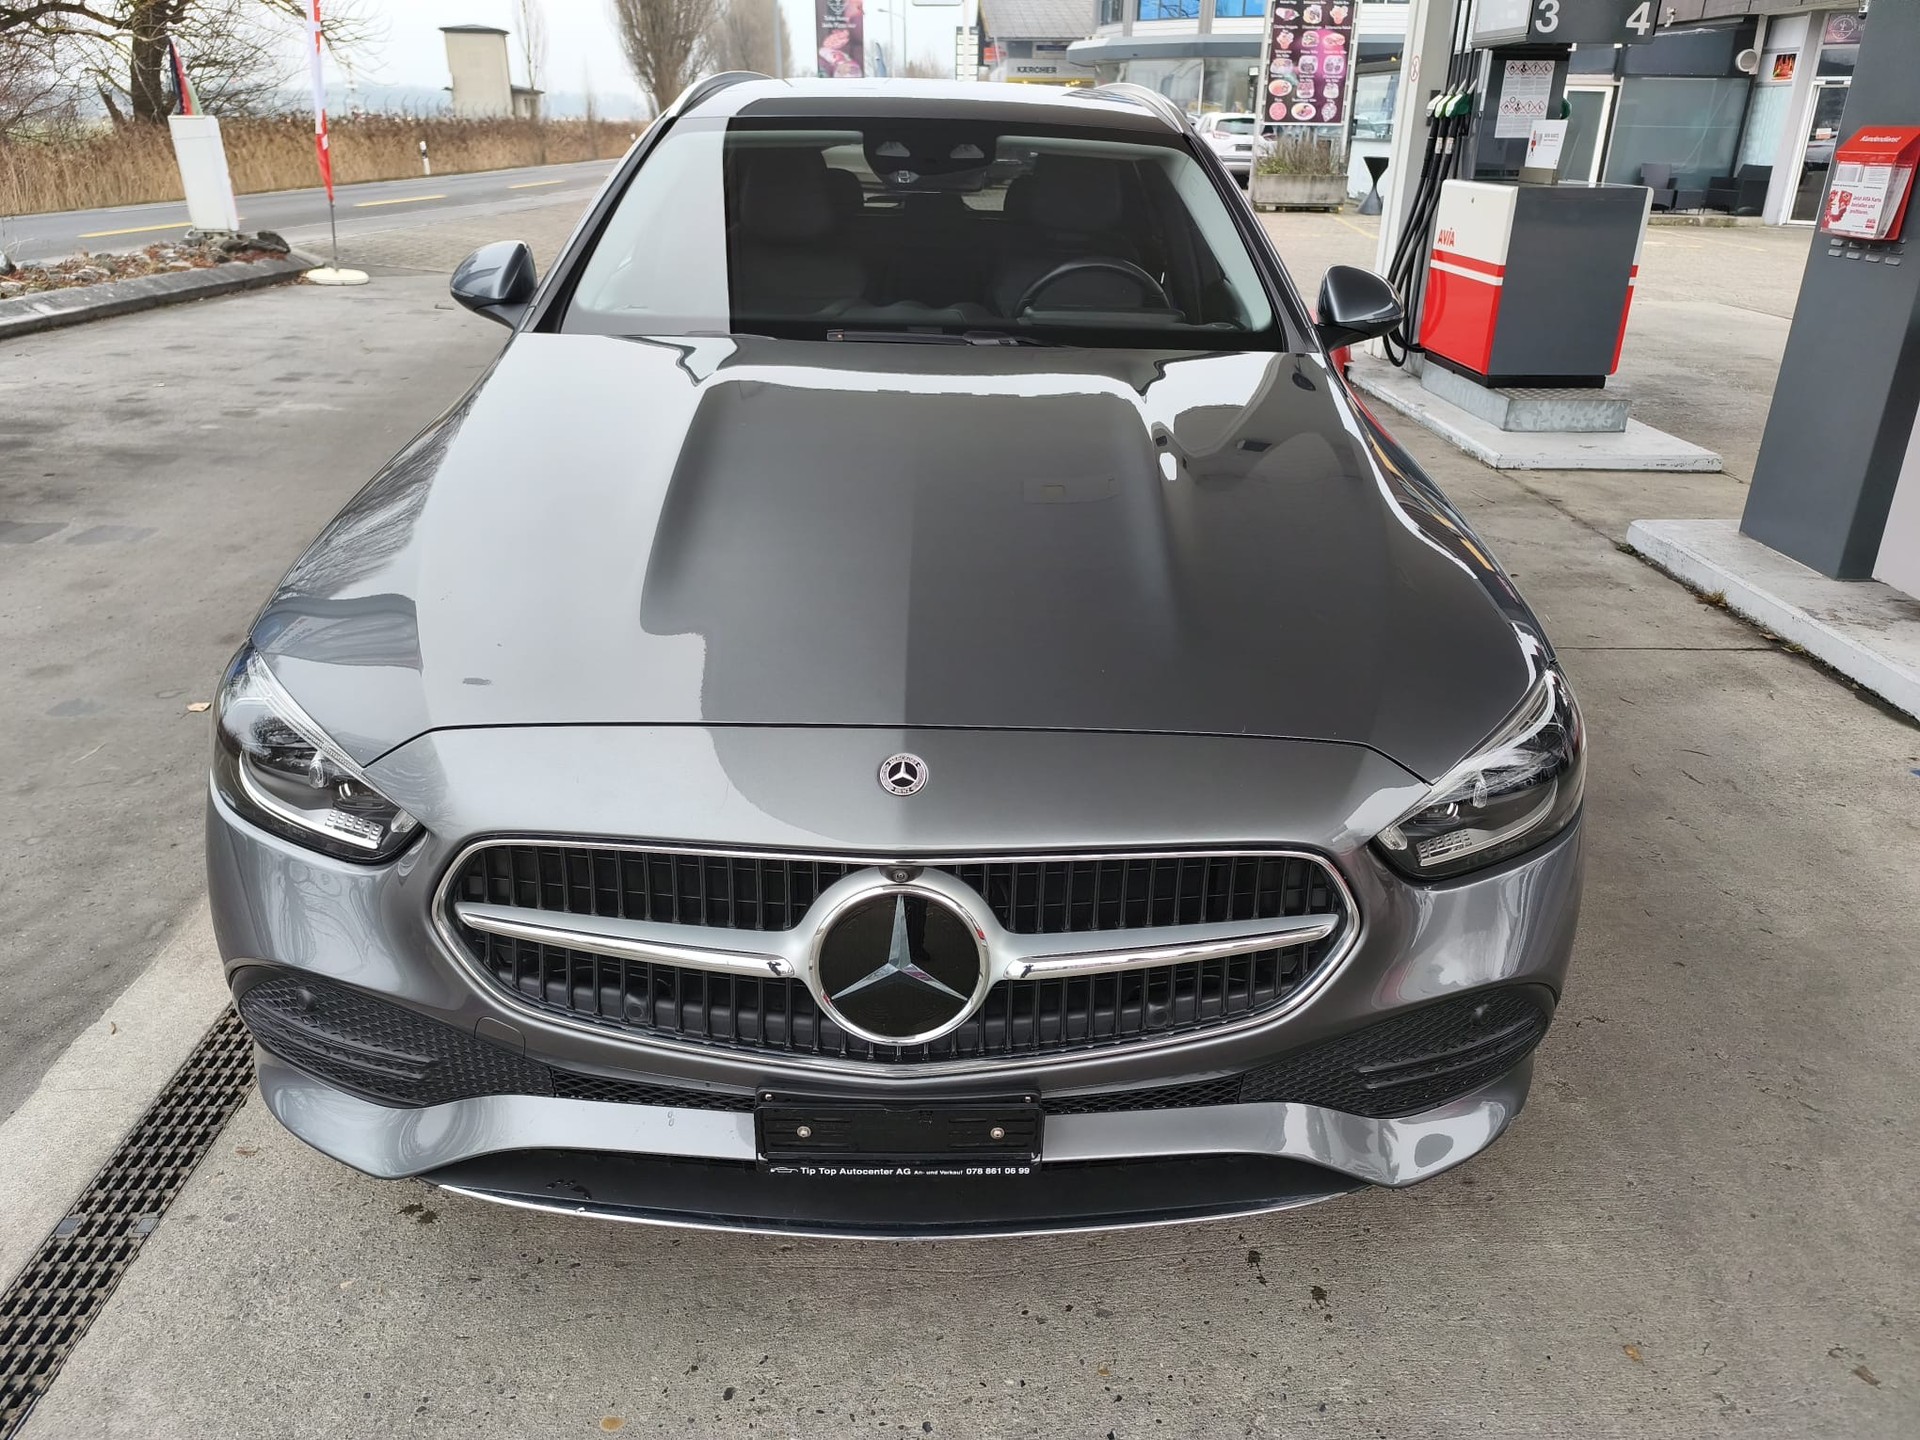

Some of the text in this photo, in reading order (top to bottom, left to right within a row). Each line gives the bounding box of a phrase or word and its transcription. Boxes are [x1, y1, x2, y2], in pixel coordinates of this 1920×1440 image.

[1535, 0, 1560, 33] 3
[1625, 2, 1650, 36] 4
[1437, 229, 1456, 247] AVIA
[800, 1167, 816, 1176] Tip
[818, 1167, 837, 1176] Top
[839, 1167, 893, 1176] Autocenter
[896, 1167, 911, 1176] AG
[966, 1167, 983, 1175] 078
[1018, 1167, 1030, 1175] 99
